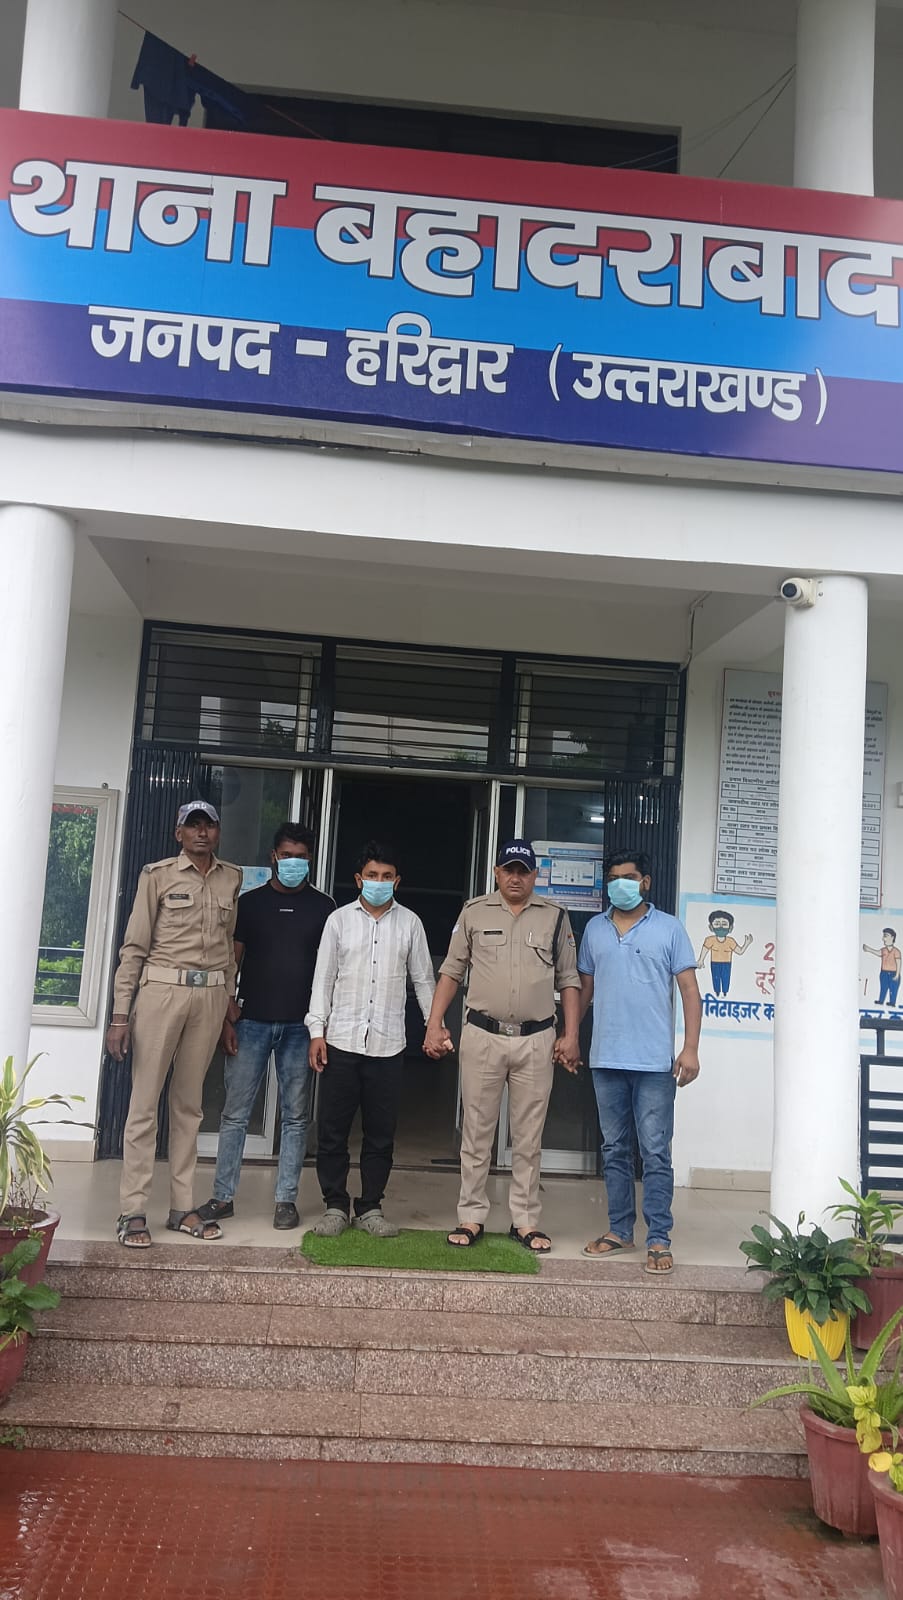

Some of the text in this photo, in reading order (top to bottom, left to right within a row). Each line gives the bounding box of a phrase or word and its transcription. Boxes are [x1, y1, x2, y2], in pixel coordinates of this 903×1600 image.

[10, 160, 903, 328] थाना बहादराबाद
[88, 305, 280, 375] जनपद
[345, 312, 515, 395] हरिद्वार
[505, 845, 531, 856] POLICE
[701, 993, 761, 1023] निटाइजर
